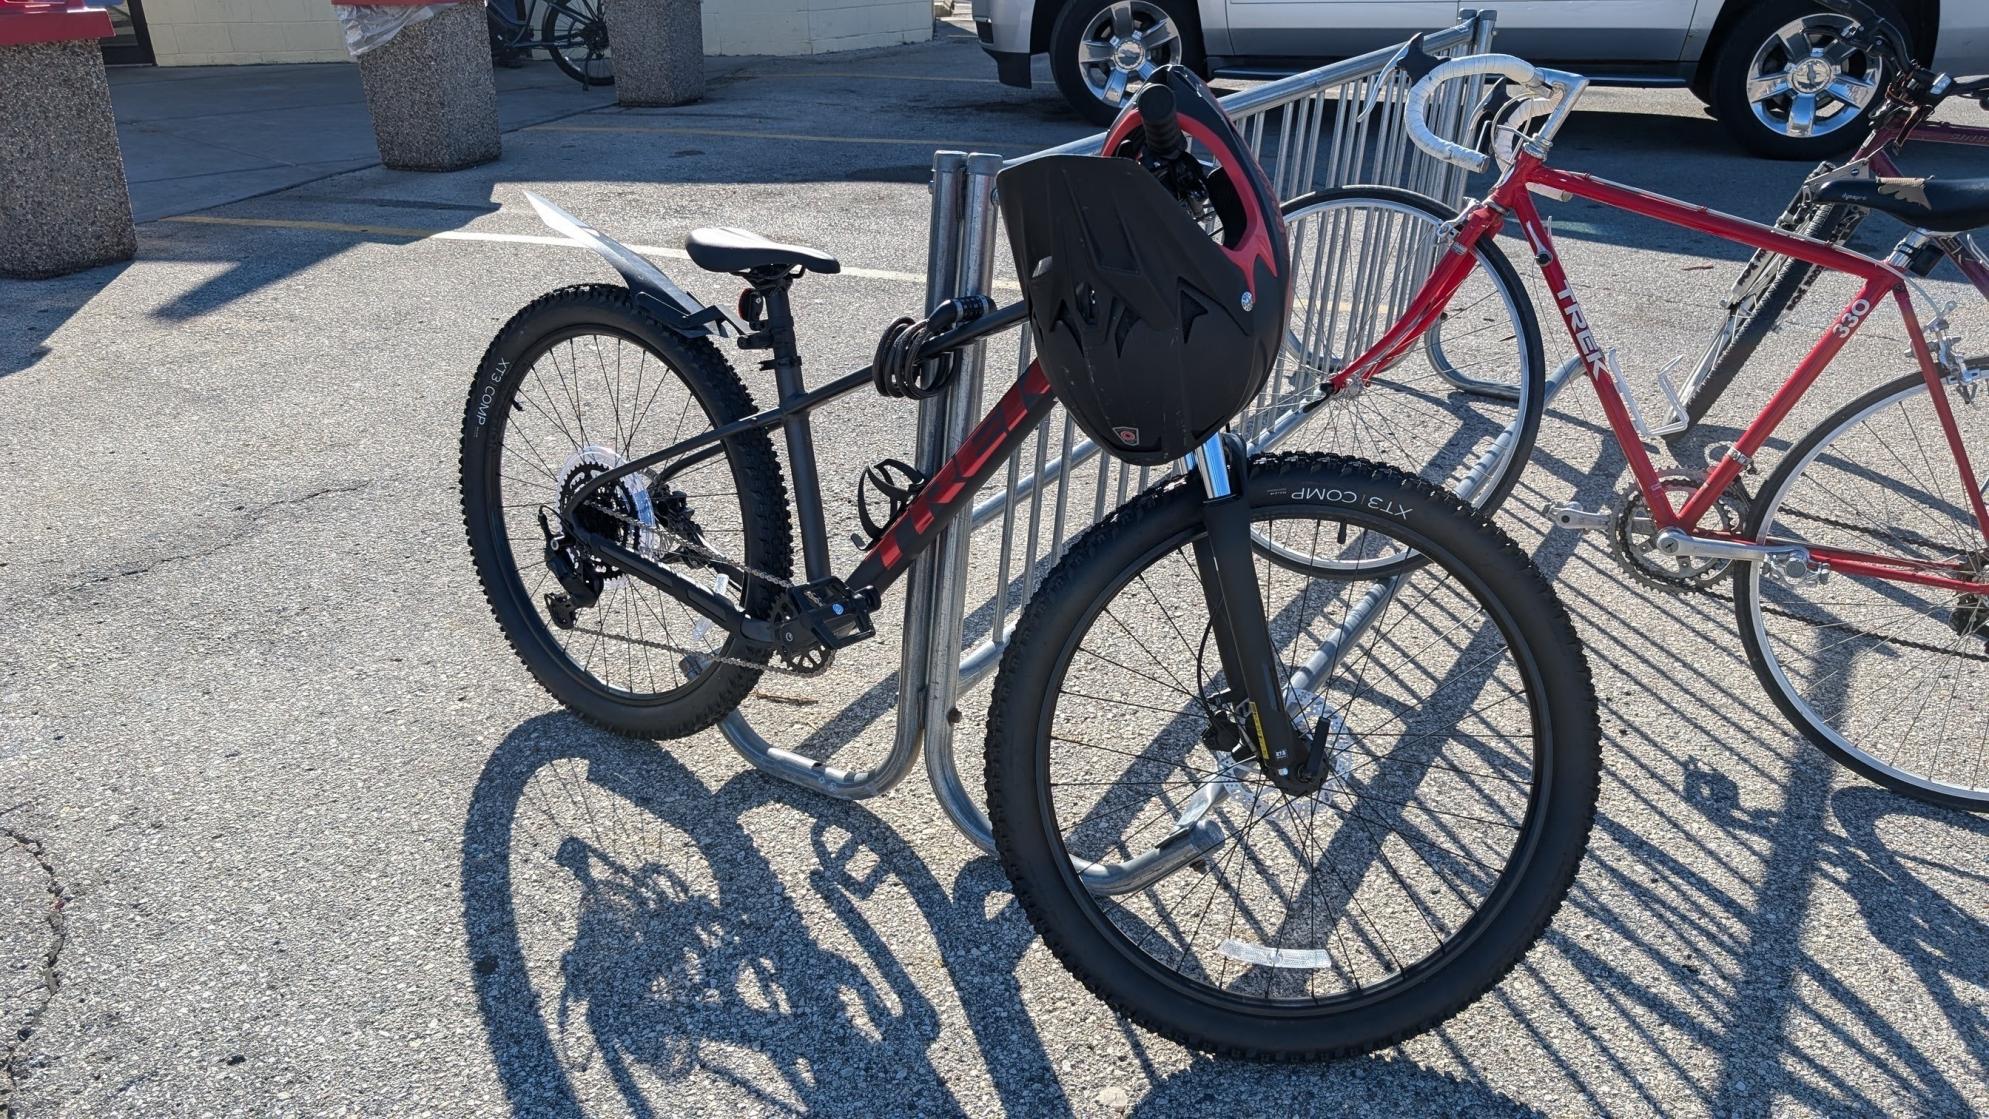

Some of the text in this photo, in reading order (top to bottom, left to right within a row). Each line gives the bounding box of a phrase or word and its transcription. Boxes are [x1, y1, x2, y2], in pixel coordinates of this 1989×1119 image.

[1557, 279, 1609, 381] TREK
[1833, 298, 1870, 338] 330
[476, 357, 510, 425] XT3 COMP
[1291, 487, 1414, 520] XT3 COMP
